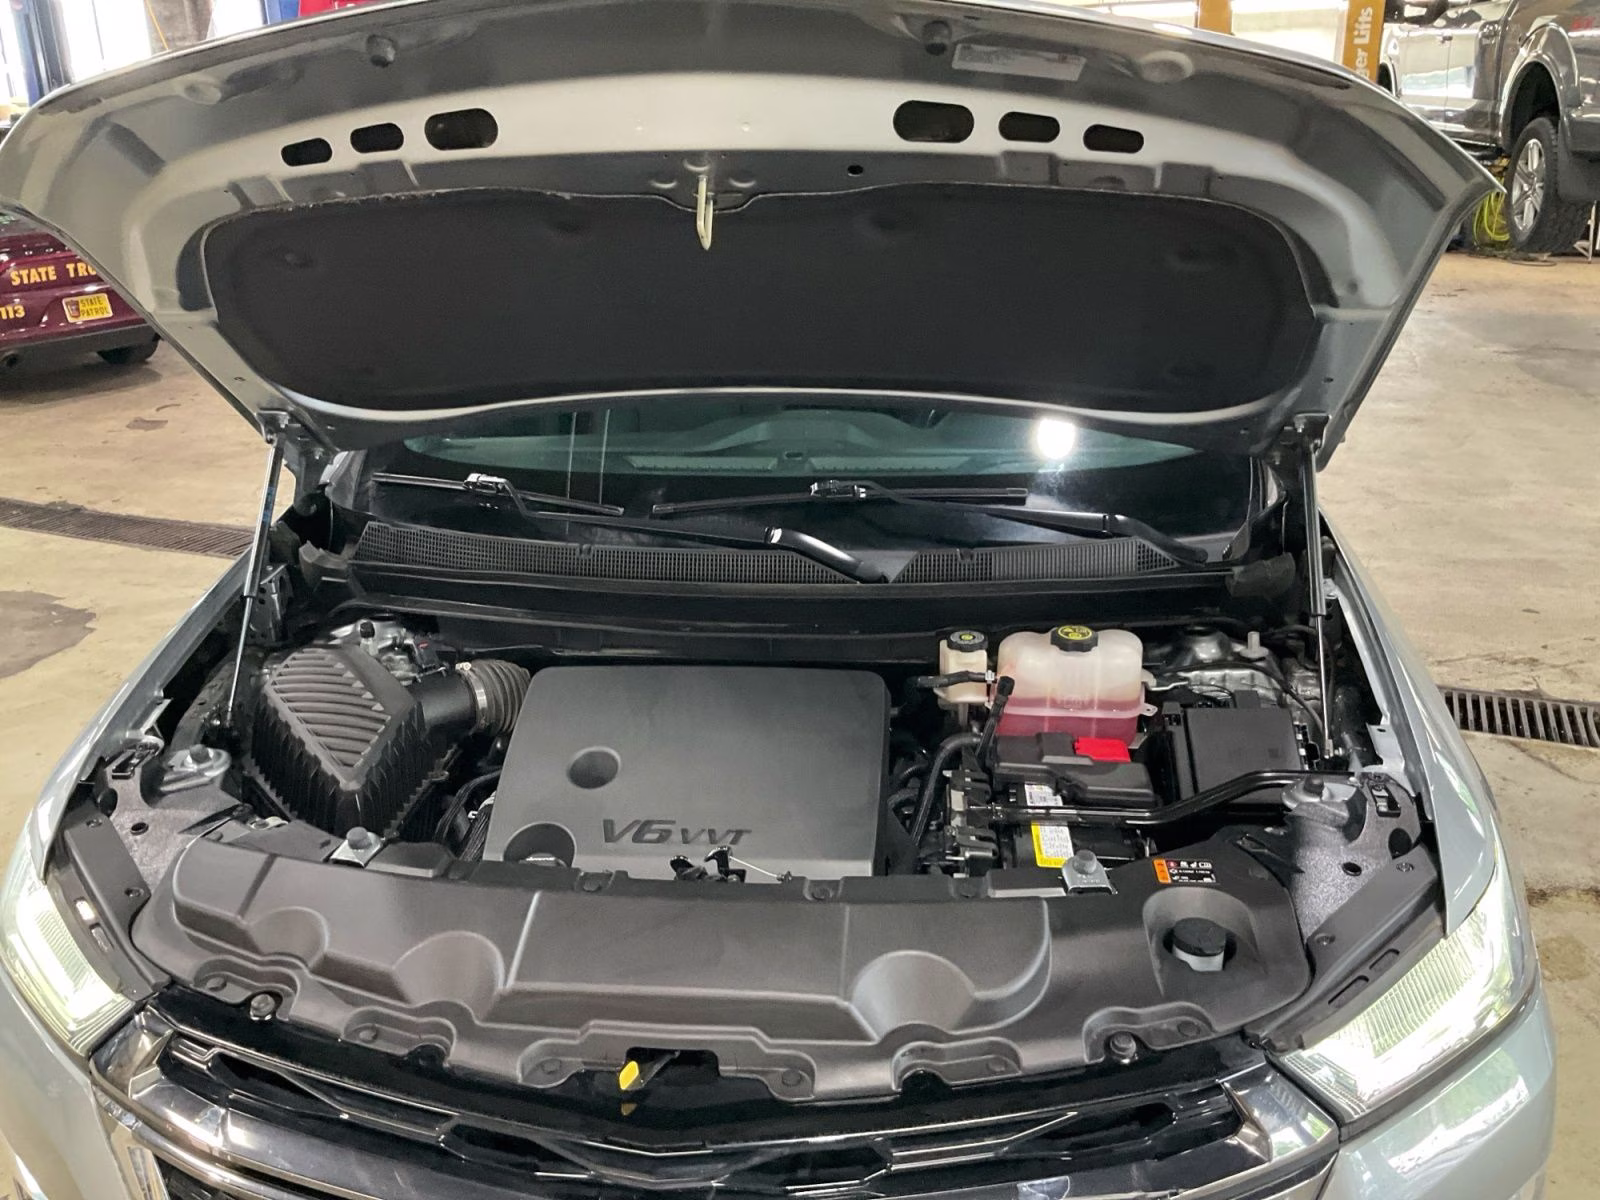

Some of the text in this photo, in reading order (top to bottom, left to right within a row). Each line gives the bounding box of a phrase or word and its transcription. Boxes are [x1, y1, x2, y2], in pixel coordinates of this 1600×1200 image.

[1353, 6, 1373, 45] Lifts
[10, 265, 57, 286] STATE
[80, 296, 103, 307] STATE
[0, 304, 25, 320] 113
[81, 306, 110, 317] PATROL
[602, 818, 752, 845] V6 VVT
